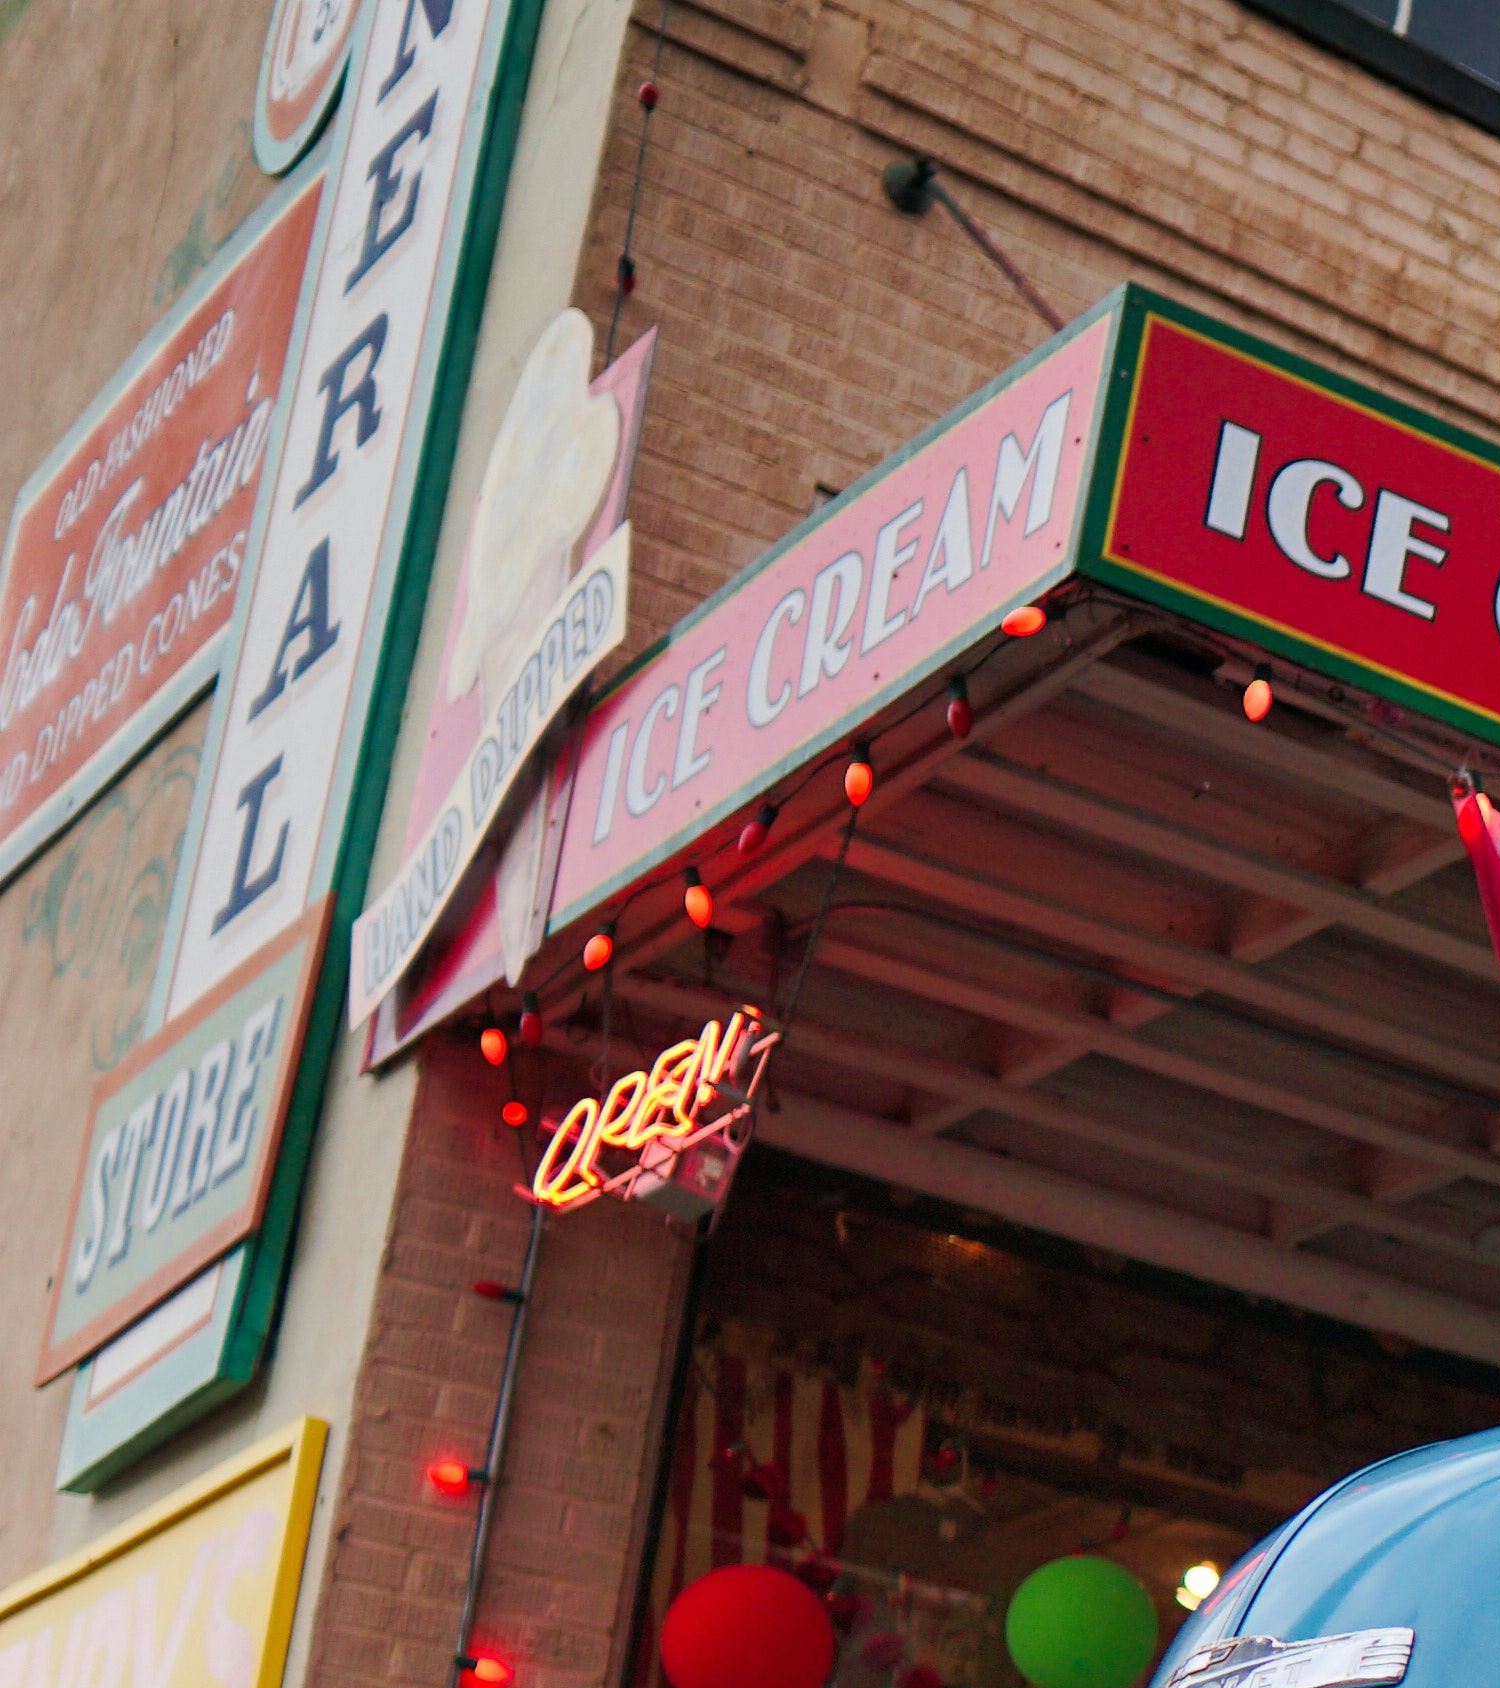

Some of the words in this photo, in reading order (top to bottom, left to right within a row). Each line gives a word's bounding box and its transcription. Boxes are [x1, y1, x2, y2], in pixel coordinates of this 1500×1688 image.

[54, 457, 101, 542] OLD
[99, 308, 235, 490] FASHIONED
[70, 370, 276, 658] Fountain
[1204, 418, 1451, 622] ICE
[30, 641, 134, 785] DIPPED
[138, 529, 247, 678] CONES
[591, 644, 728, 849] ICE
[746, 388, 1073, 729] CREAM
[363, 806, 464, 996] HAND
[470, 566, 616, 822] DIPPED
[75, 995, 285, 1296] STORE
[536, 1007, 752, 1205] OPEN
